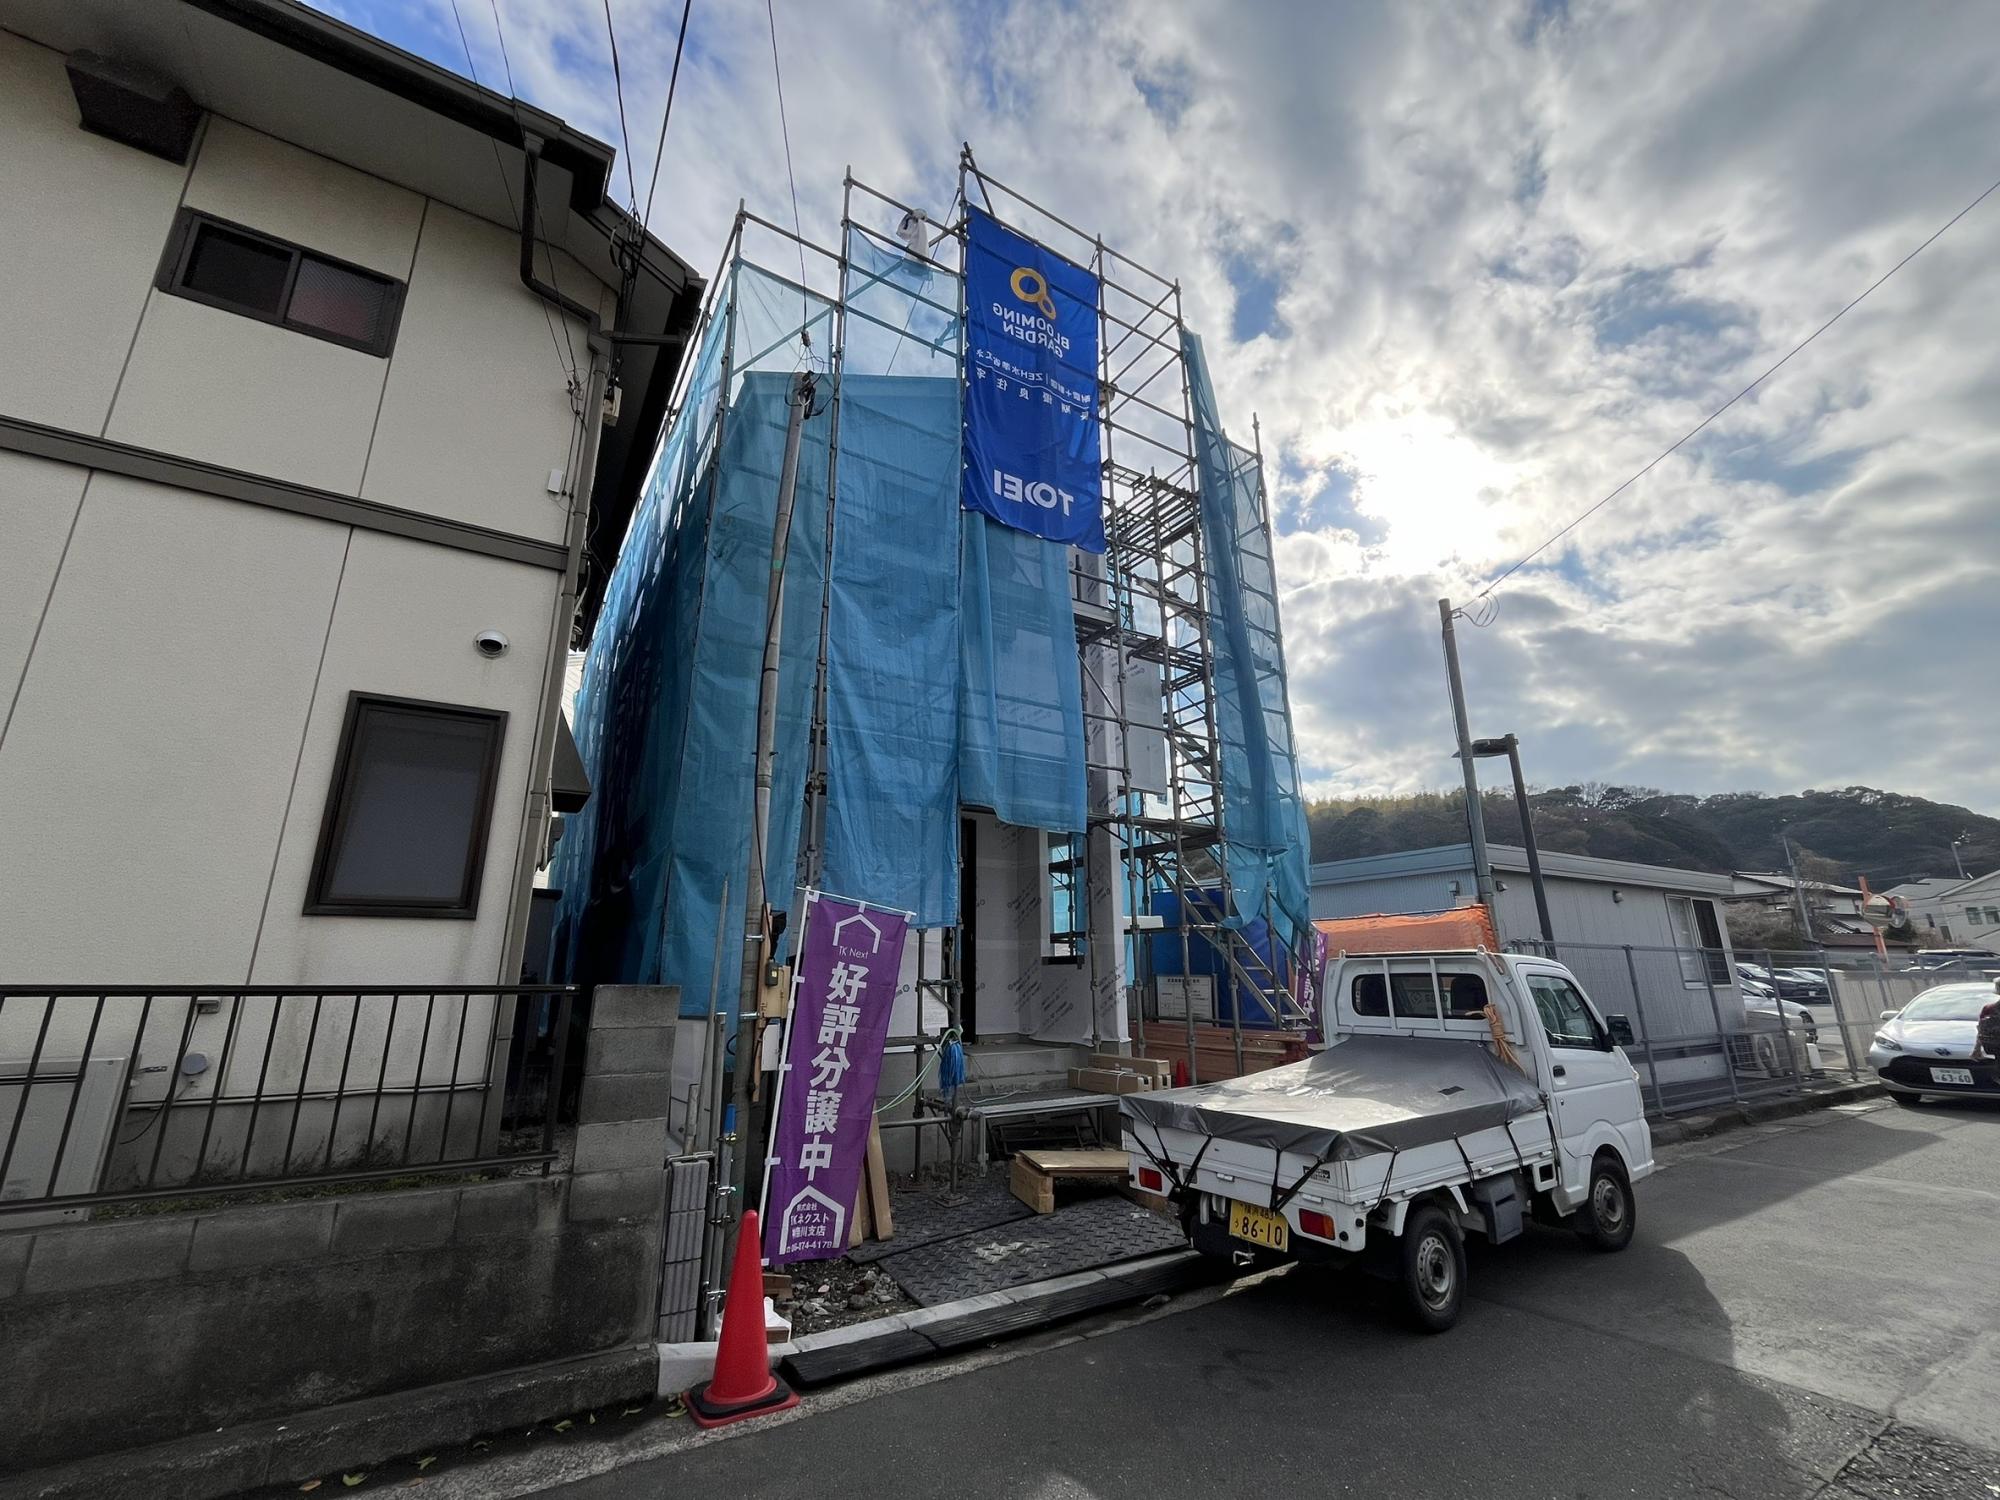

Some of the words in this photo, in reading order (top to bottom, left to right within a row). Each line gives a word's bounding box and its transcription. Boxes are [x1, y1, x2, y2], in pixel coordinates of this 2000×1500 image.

[839, 945, 847, 956] TK
[850, 947, 868, 960] Next
[799, 961, 870, 1182] 好評分譲中
[1242, 1216, 1283, 1246] 86-10
